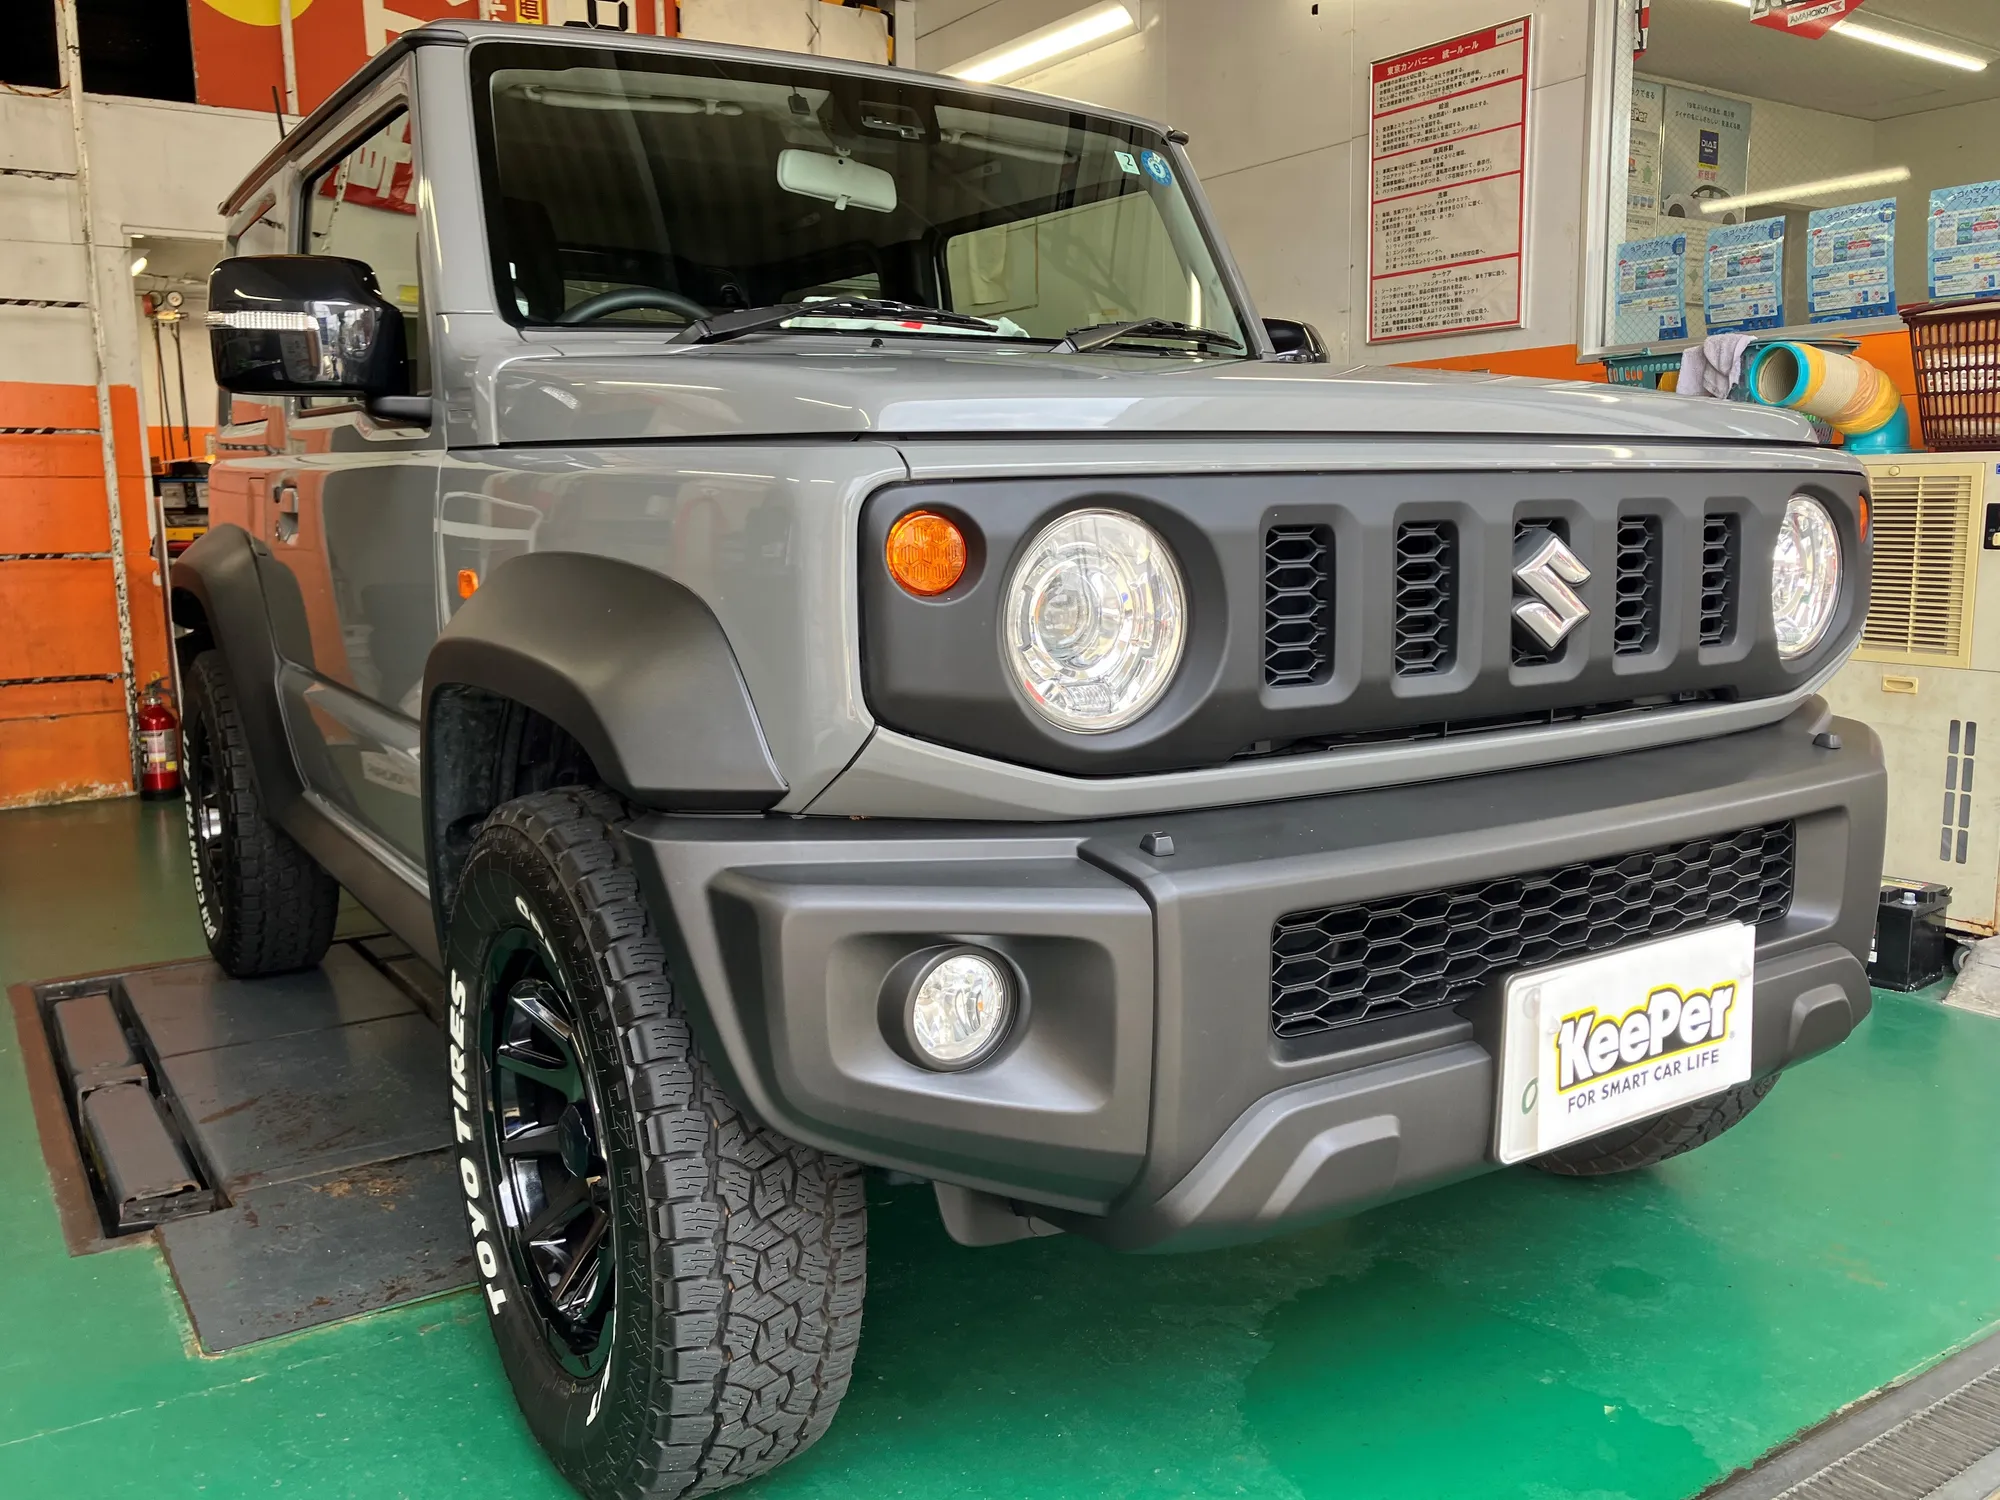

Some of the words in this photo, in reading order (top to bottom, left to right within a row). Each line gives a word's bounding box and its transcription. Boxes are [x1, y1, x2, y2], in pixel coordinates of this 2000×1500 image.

[1387, 55, 1434, 76] 東京カンパニー
[1123, 154, 1133, 166] 2
[1722, 224, 1767, 238] ヨコハマタイヤ
[1630, 240, 1672, 253] ヨコハマタイヤ
[1431, 270, 1451, 278] カーケア
[1555, 980, 1737, 1094] KeePer
[449, 968, 473, 1143] TIRES
[1567, 1092, 1595, 1113] FOR
[1601, 1069, 1649, 1101] SMART
[1654, 1060, 1680, 1082] CAR
[1687, 1049, 1719, 1071] LIFE
[460, 1157, 507, 1315] TOYO
